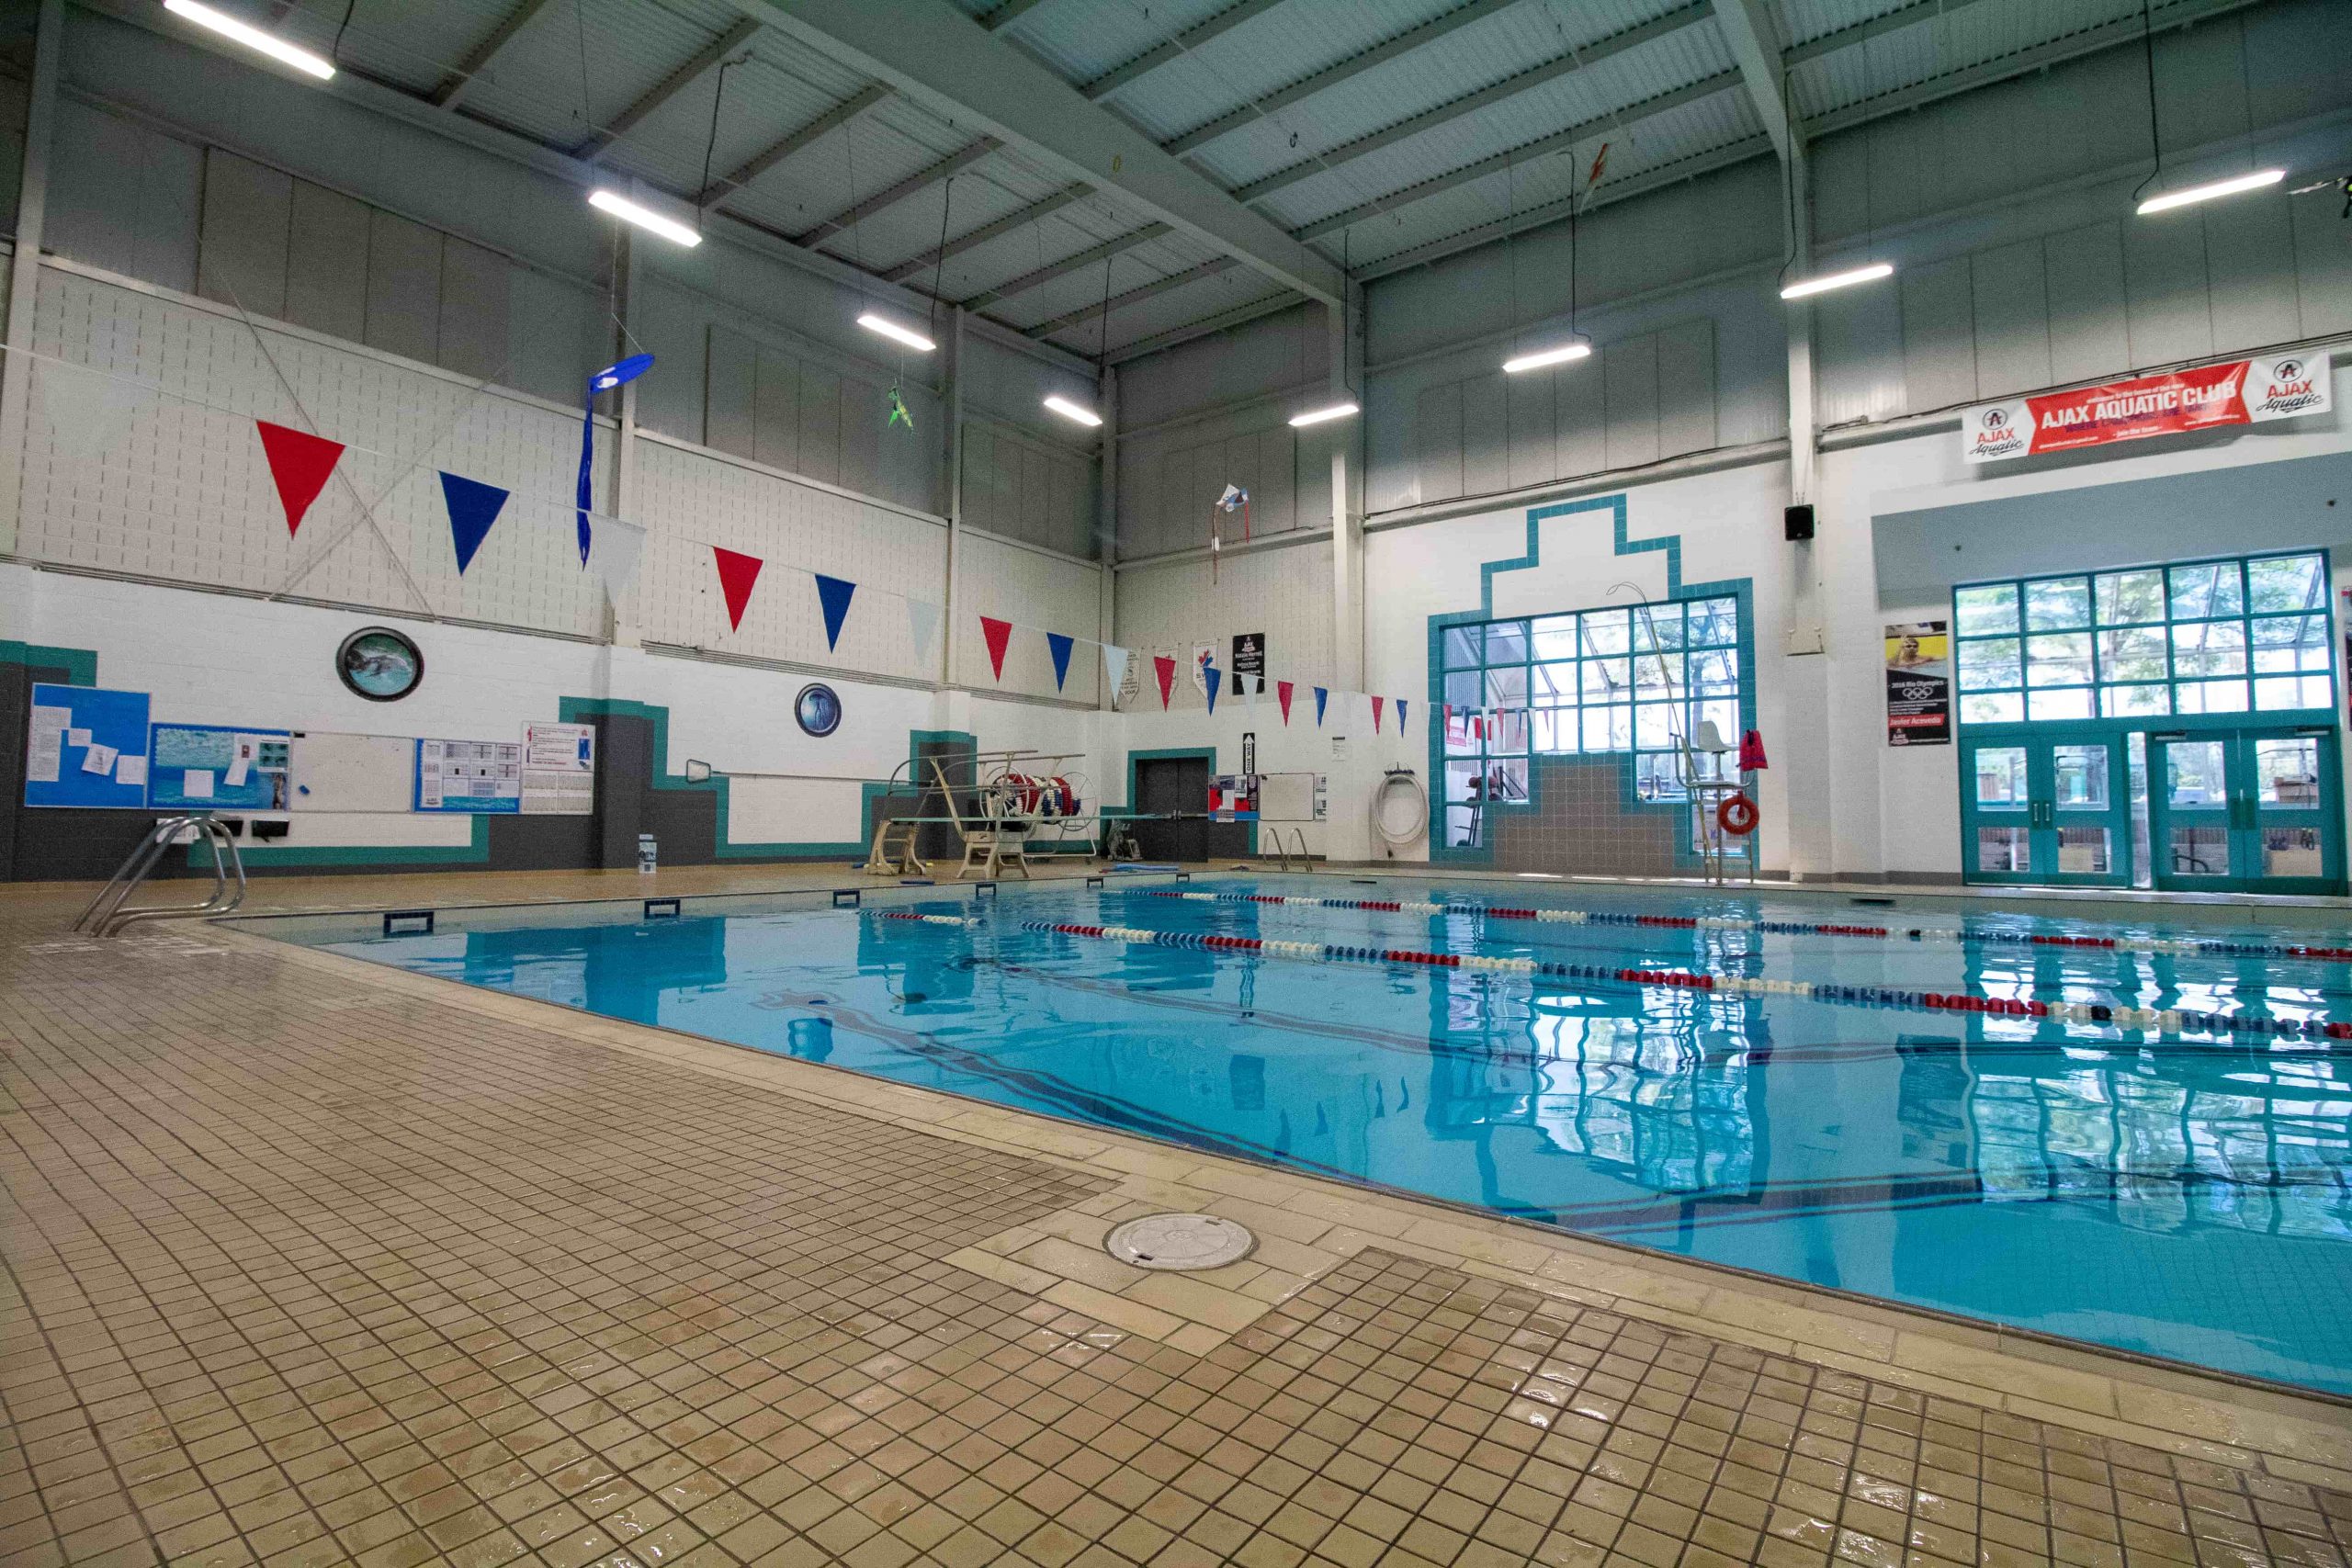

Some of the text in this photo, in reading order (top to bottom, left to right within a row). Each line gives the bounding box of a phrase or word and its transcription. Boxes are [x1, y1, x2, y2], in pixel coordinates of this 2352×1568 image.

[2267, 379, 2312, 400] AJAX
[2041, 404, 2090, 429] AJAX
[2095, 390, 2177, 420] AQUATIC
[2182, 380, 2237, 406] CLUB
[2256, 394, 2324, 412] Aquatic
[1977, 427, 2015, 444] AJAX
[1969, 439, 2024, 456] Aquatic
